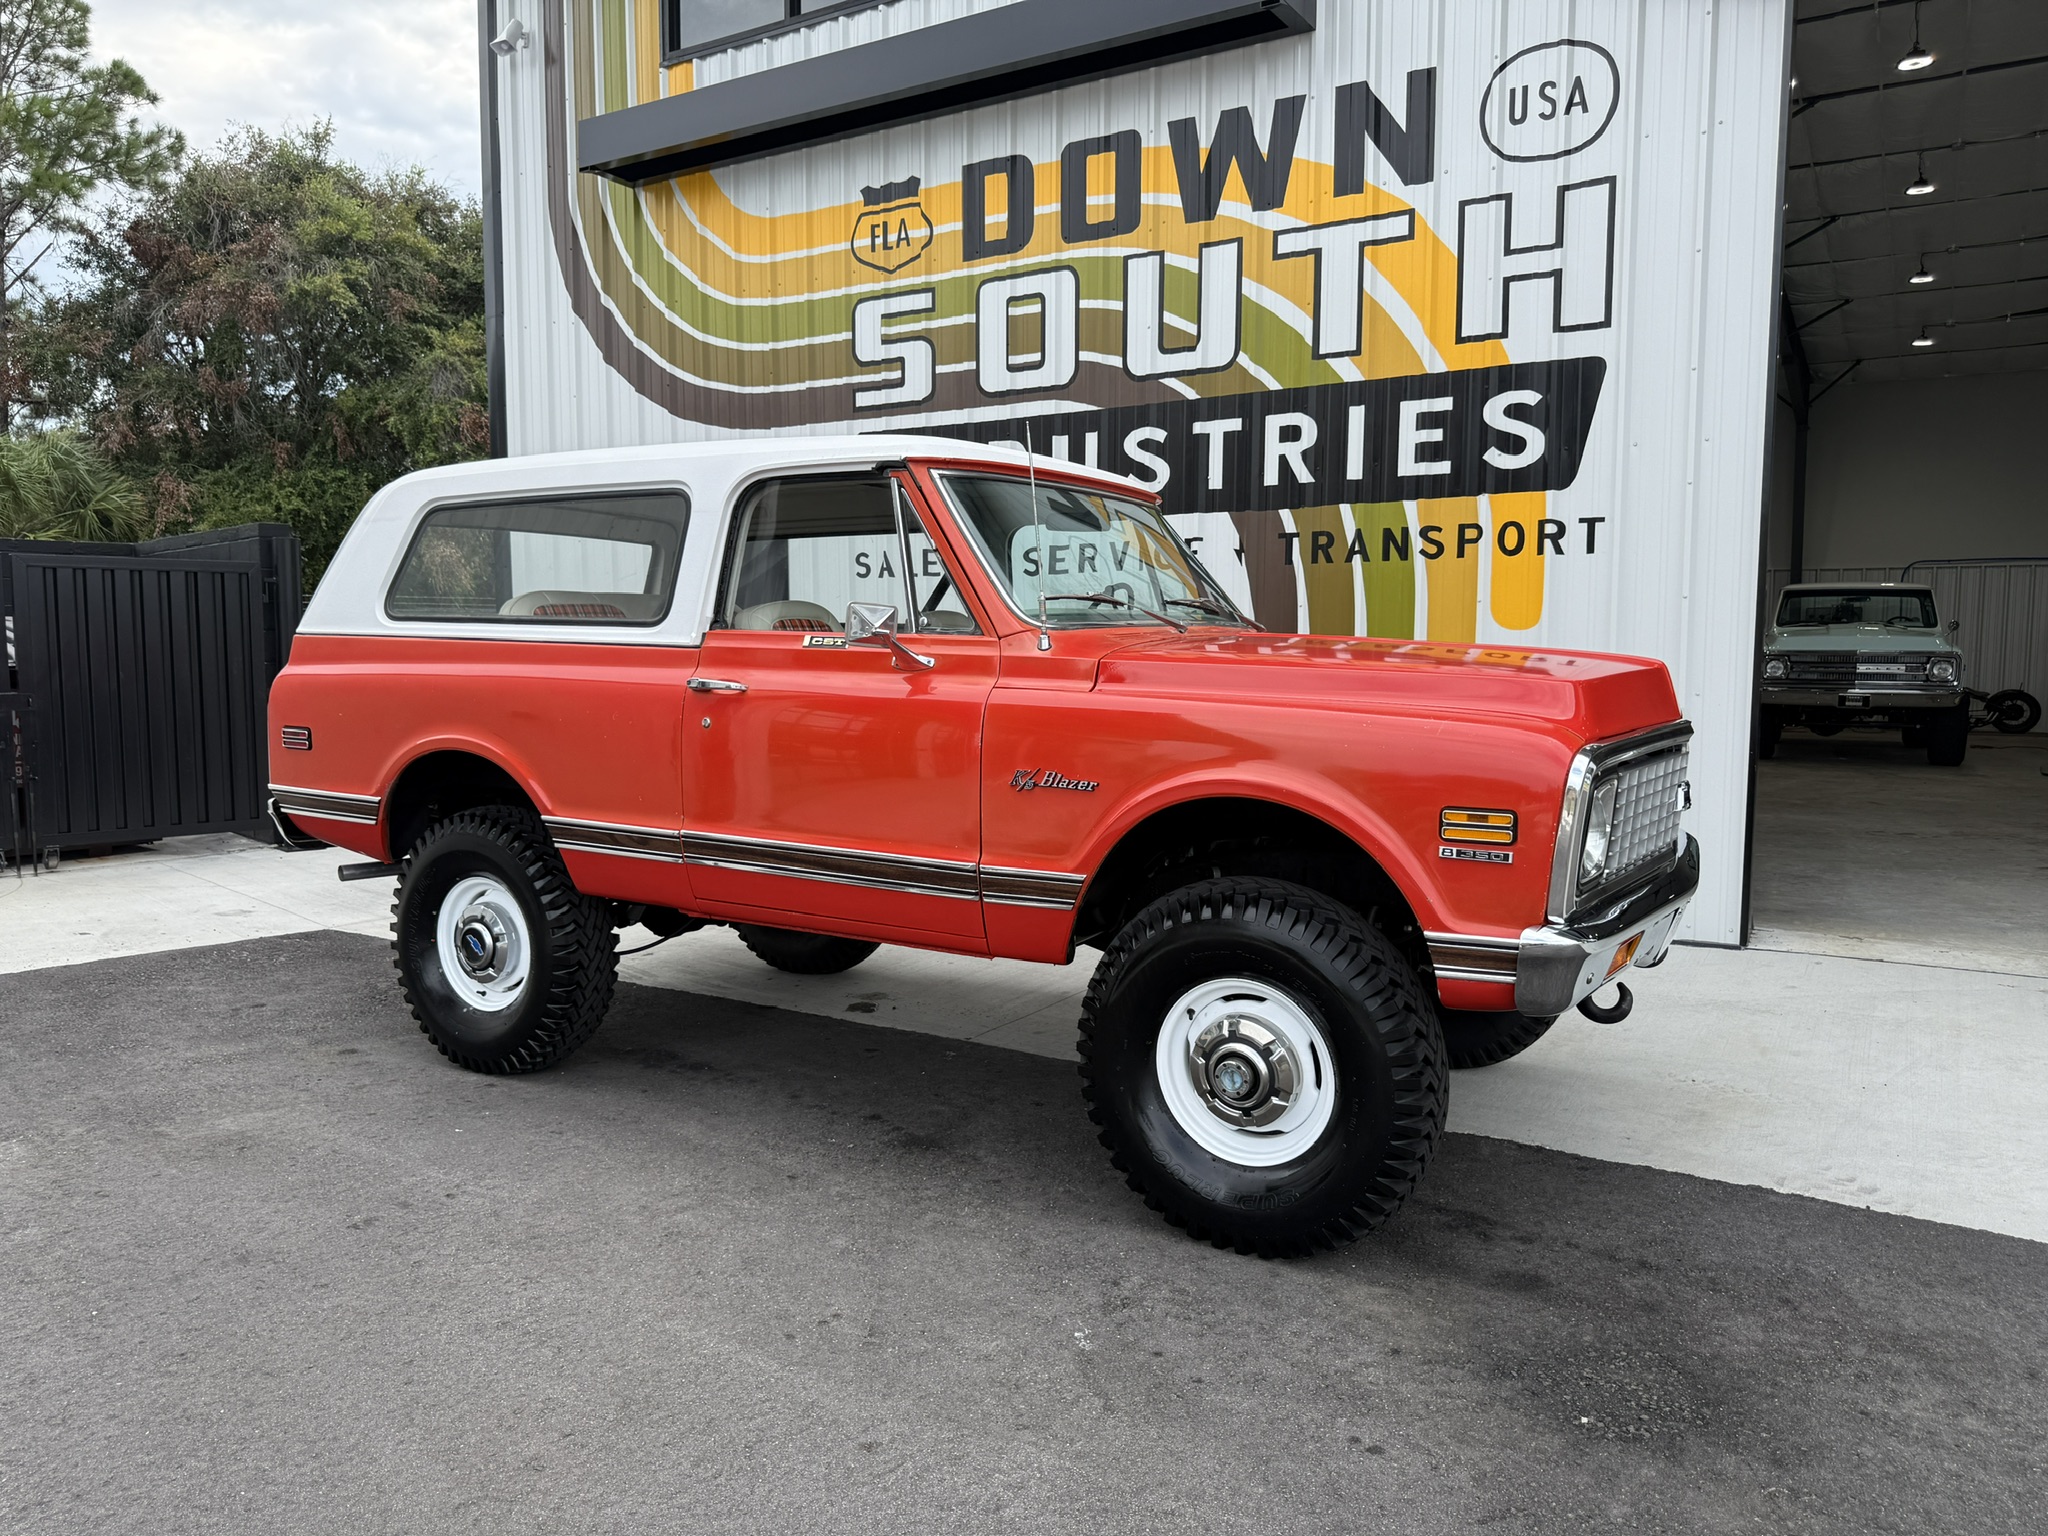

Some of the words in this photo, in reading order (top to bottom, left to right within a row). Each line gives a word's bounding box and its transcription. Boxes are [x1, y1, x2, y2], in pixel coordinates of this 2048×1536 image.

[1507, 75, 1591, 127] USA
[962, 66, 1438, 262] DOWN
[869, 217, 912, 254] FLA
[852, 175, 1617, 411] SOUTH
[1278, 516, 1606, 565] TRANSPORT
[811, 637, 846, 646] CST
[1038, 770, 1099, 792] Blazer
[1460, 850, 1504, 860] 350
